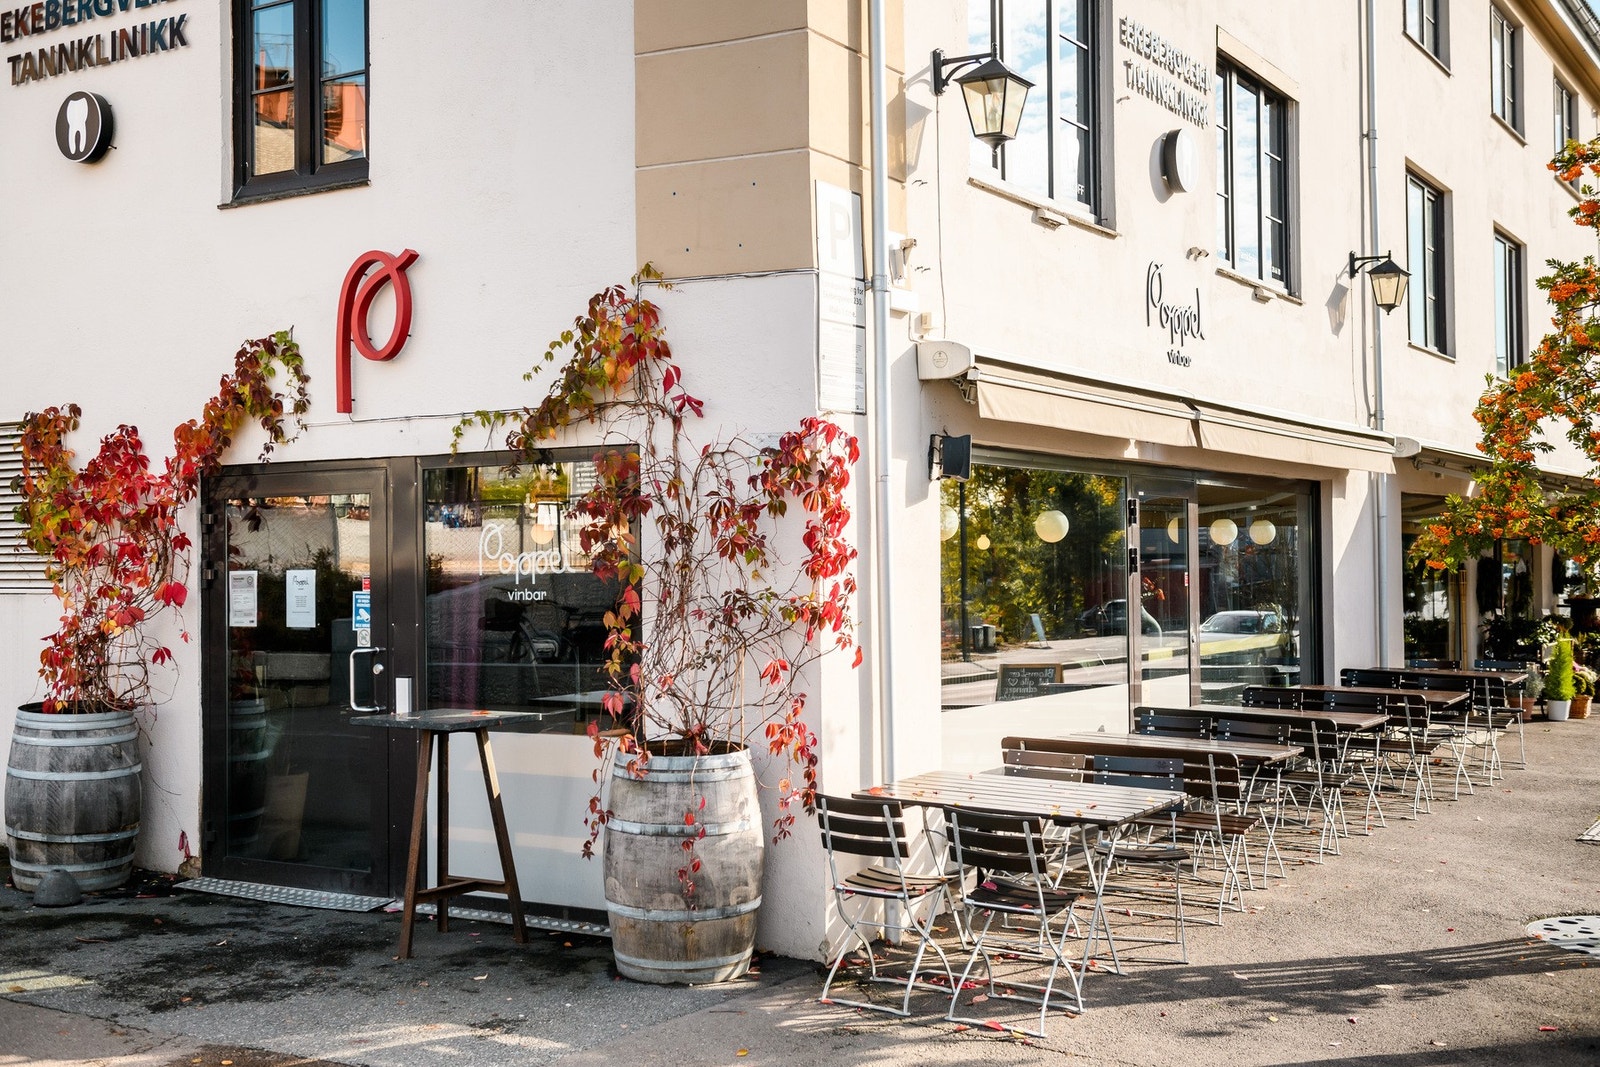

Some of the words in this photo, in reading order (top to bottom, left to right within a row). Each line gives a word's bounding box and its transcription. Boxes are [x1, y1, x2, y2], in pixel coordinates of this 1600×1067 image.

[7, 13, 188, 86] TANNKLINIKK
[1146, 260, 1205, 347] Poppel
[478, 522, 577, 585] Poppel
[507, 588, 547, 601] vinbar
